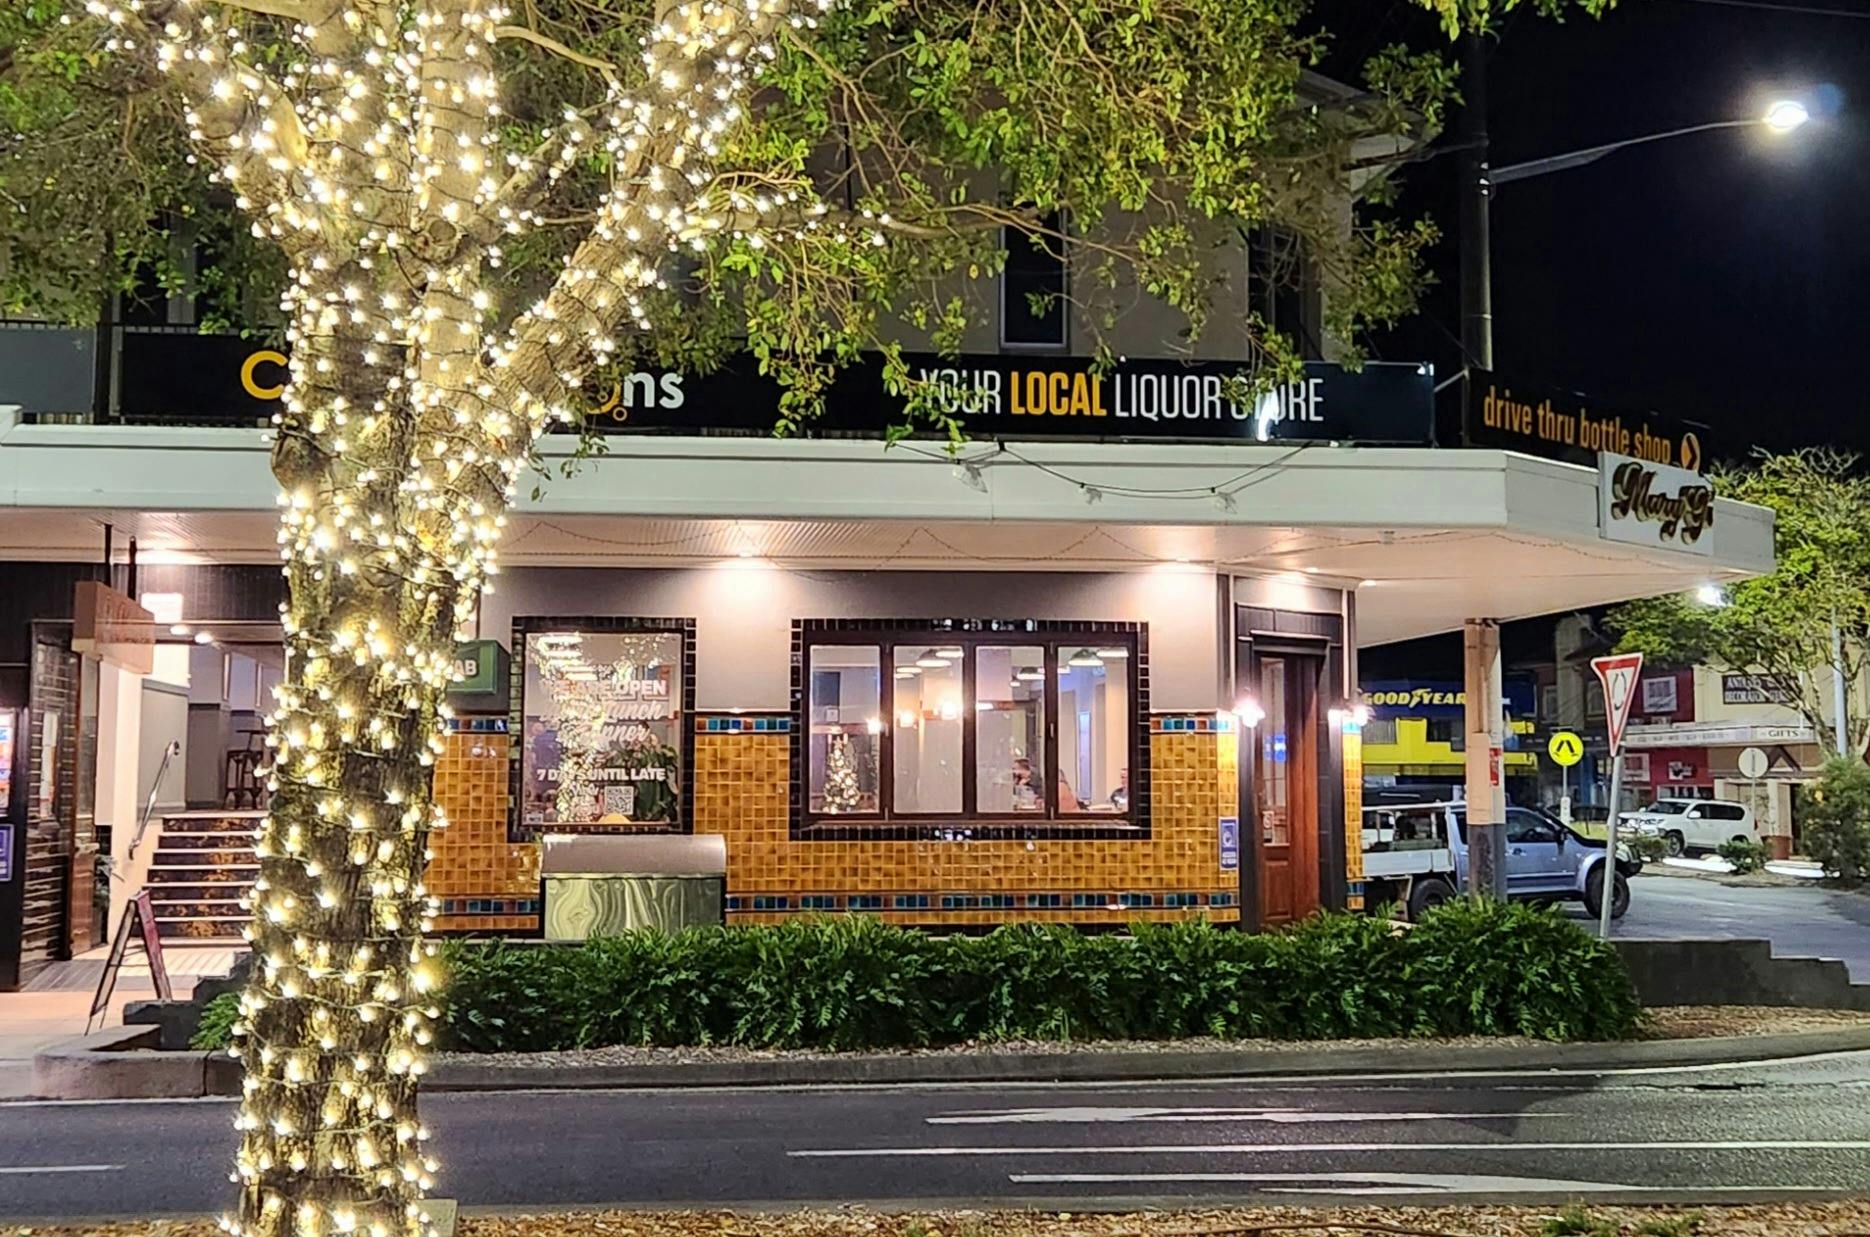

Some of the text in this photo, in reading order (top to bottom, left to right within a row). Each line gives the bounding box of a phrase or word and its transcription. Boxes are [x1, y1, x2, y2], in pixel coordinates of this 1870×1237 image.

[919, 368, 1001, 415] YOUR
[1010, 371, 1107, 416] LOCAL
[1114, 373, 1222, 421] LIQUOR
[1483, 384, 1672, 465] drive thru bottle shop
[616, 679, 667, 696] OPEN
[536, 768, 547, 781] 7
[589, 768, 629, 781] UNTIL
[630, 767, 667, 782] LATE
